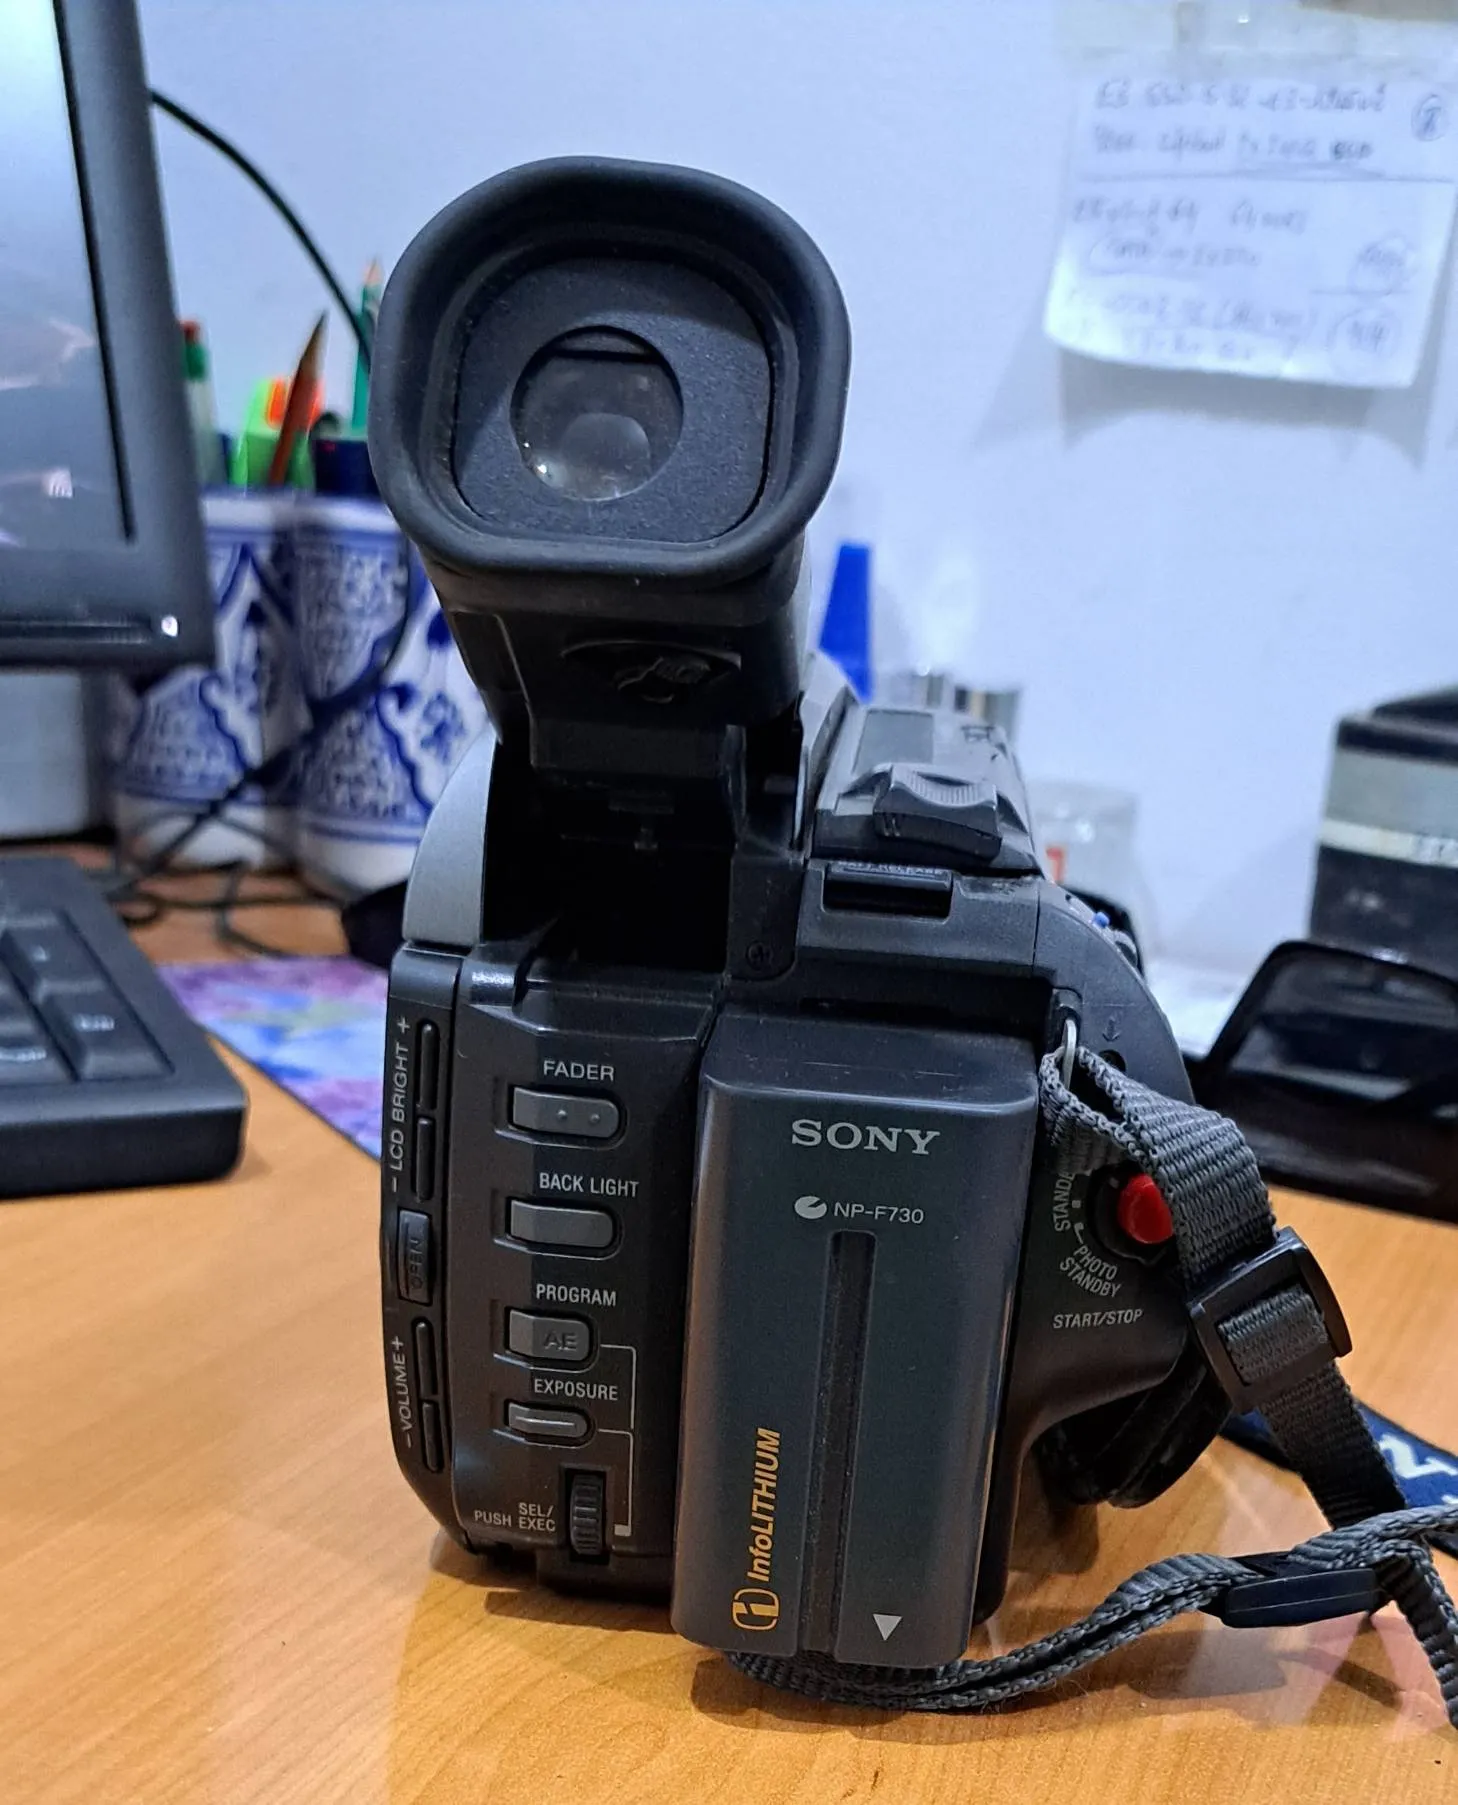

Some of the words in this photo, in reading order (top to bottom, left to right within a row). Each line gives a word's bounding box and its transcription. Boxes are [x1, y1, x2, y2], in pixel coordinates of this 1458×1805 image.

[543, 1060, 615, 1081] FADER
[391, 1044, 410, 1122] BRIGHT
[792, 1119, 940, 1155] SONY
[389, 1129, 405, 1171] LCD
[539, 1172, 585, 1192] BACK
[590, 1177, 639, 1197] LIGHT
[833, 1202, 924, 1224] NP-F730
[1073, 1245, 1118, 1281] PHOTO
[1060, 1257, 1122, 1298] STANDBY
[536, 1284, 617, 1306] PROGRAM
[1053, 1308, 1143, 1329] START/STOP
[543, 1331, 578, 1350] AE
[534, 1379, 618, 1401] EXPOSURE
[518, 1502, 554, 1517] SEL/
[747, 1427, 781, 1582] InfoLITHIUM
[474, 1510, 512, 1528] PUSH
[518, 1516, 556, 1532] EXEC
